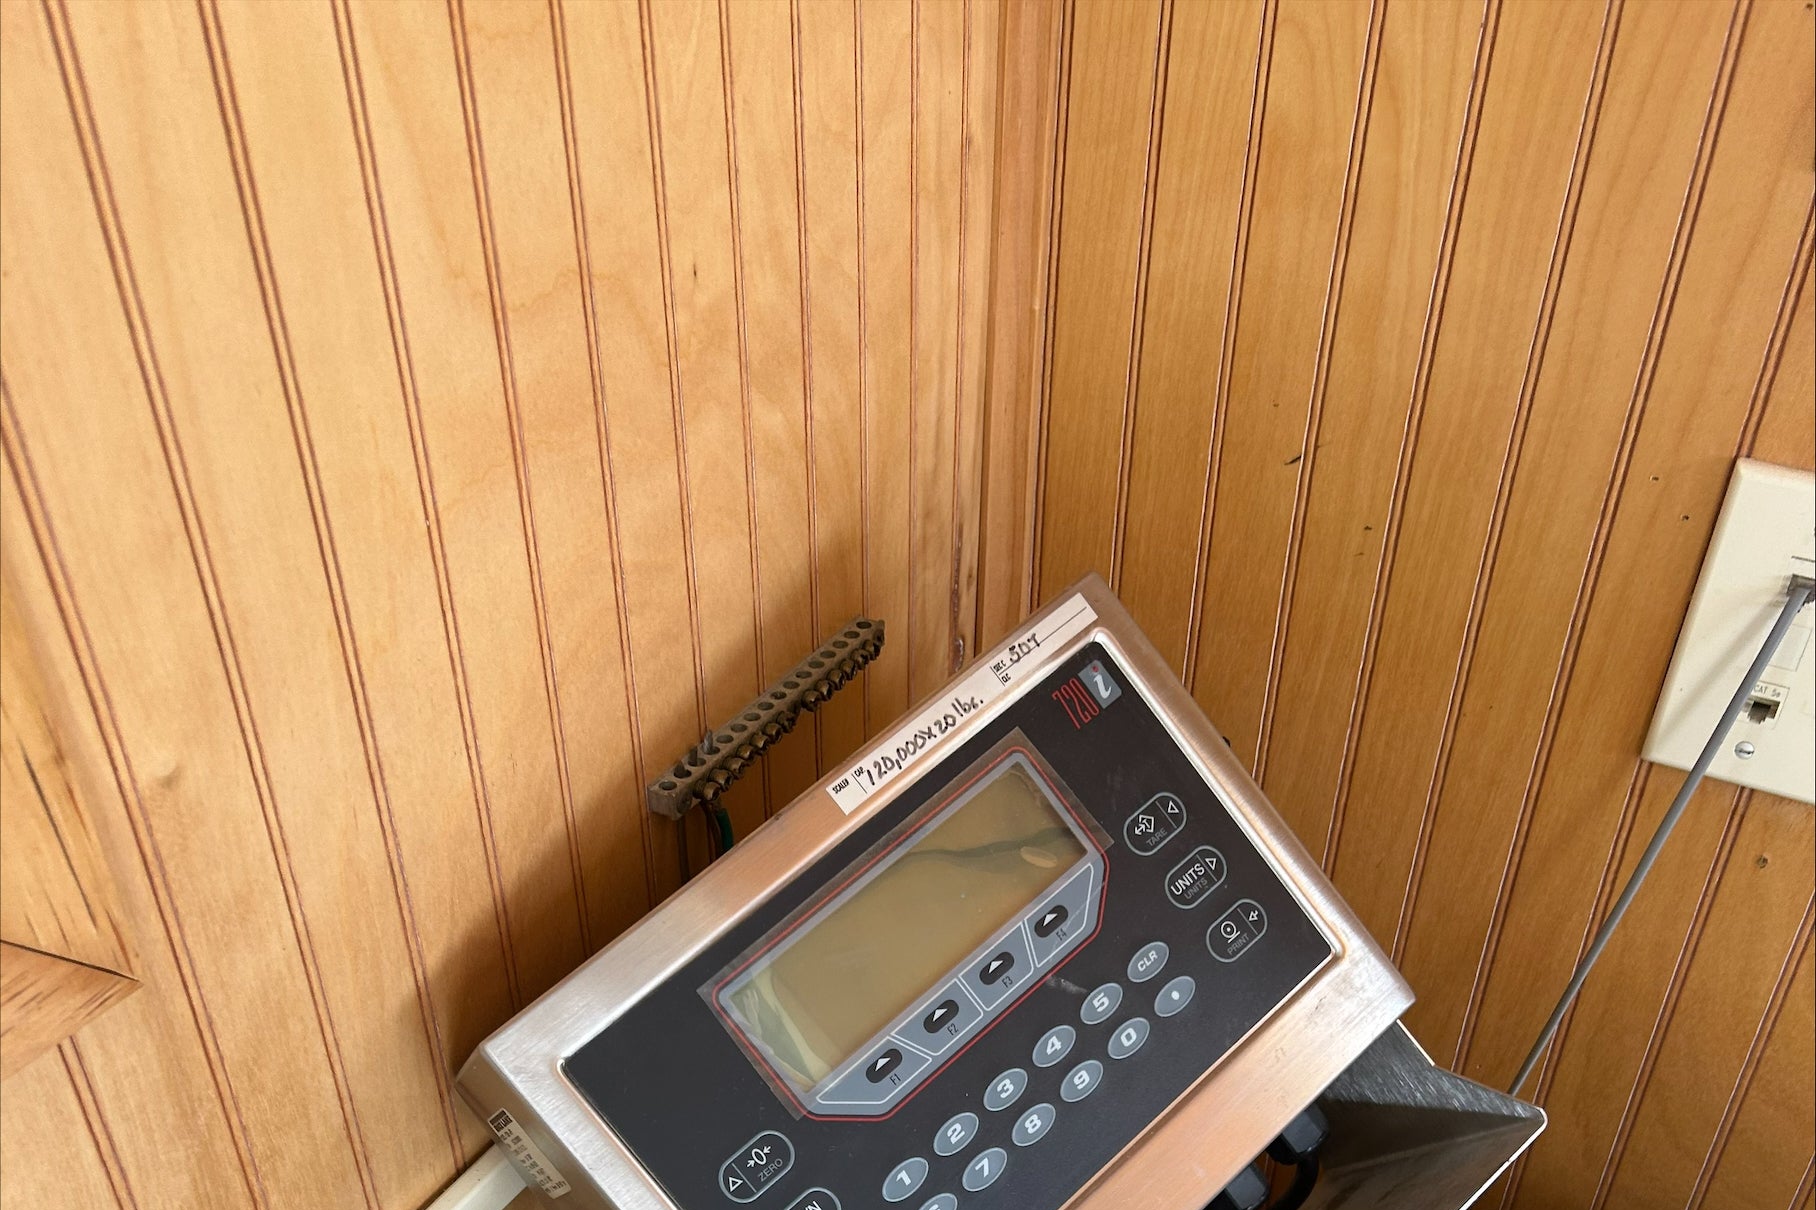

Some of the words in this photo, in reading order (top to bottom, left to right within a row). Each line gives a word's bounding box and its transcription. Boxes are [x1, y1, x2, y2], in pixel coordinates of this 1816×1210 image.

[1753, 684, 1769, 695] CAT
[1146, 826, 1168, 848] TARE
[1170, 862, 1206, 896] UNITS
[1183, 877, 1208, 900] UNITS
[1056, 927, 1068, 942] F4
[1227, 931, 1250, 956] PRINT
[1136, 948, 1159, 971] CLR
[1001, 975, 1014, 989] F3
[1092, 992, 1110, 1013] 5
[947, 1022, 959, 1036] F2
[1120, 1026, 1138, 1047] 0
[1045, 1035, 1062, 1056] 4
[890, 1072, 902, 1086] F1
[997, 1078, 1015, 1099] 3
[1073, 1069, 1091, 1090] 9
[947, 1123, 966, 1145] 2
[1024, 1113, 1042, 1135] 8
[757, 1157, 783, 1182] ZERO
[896, 1169, 912, 1187] 1
[974, 1157, 990, 1178] 7
